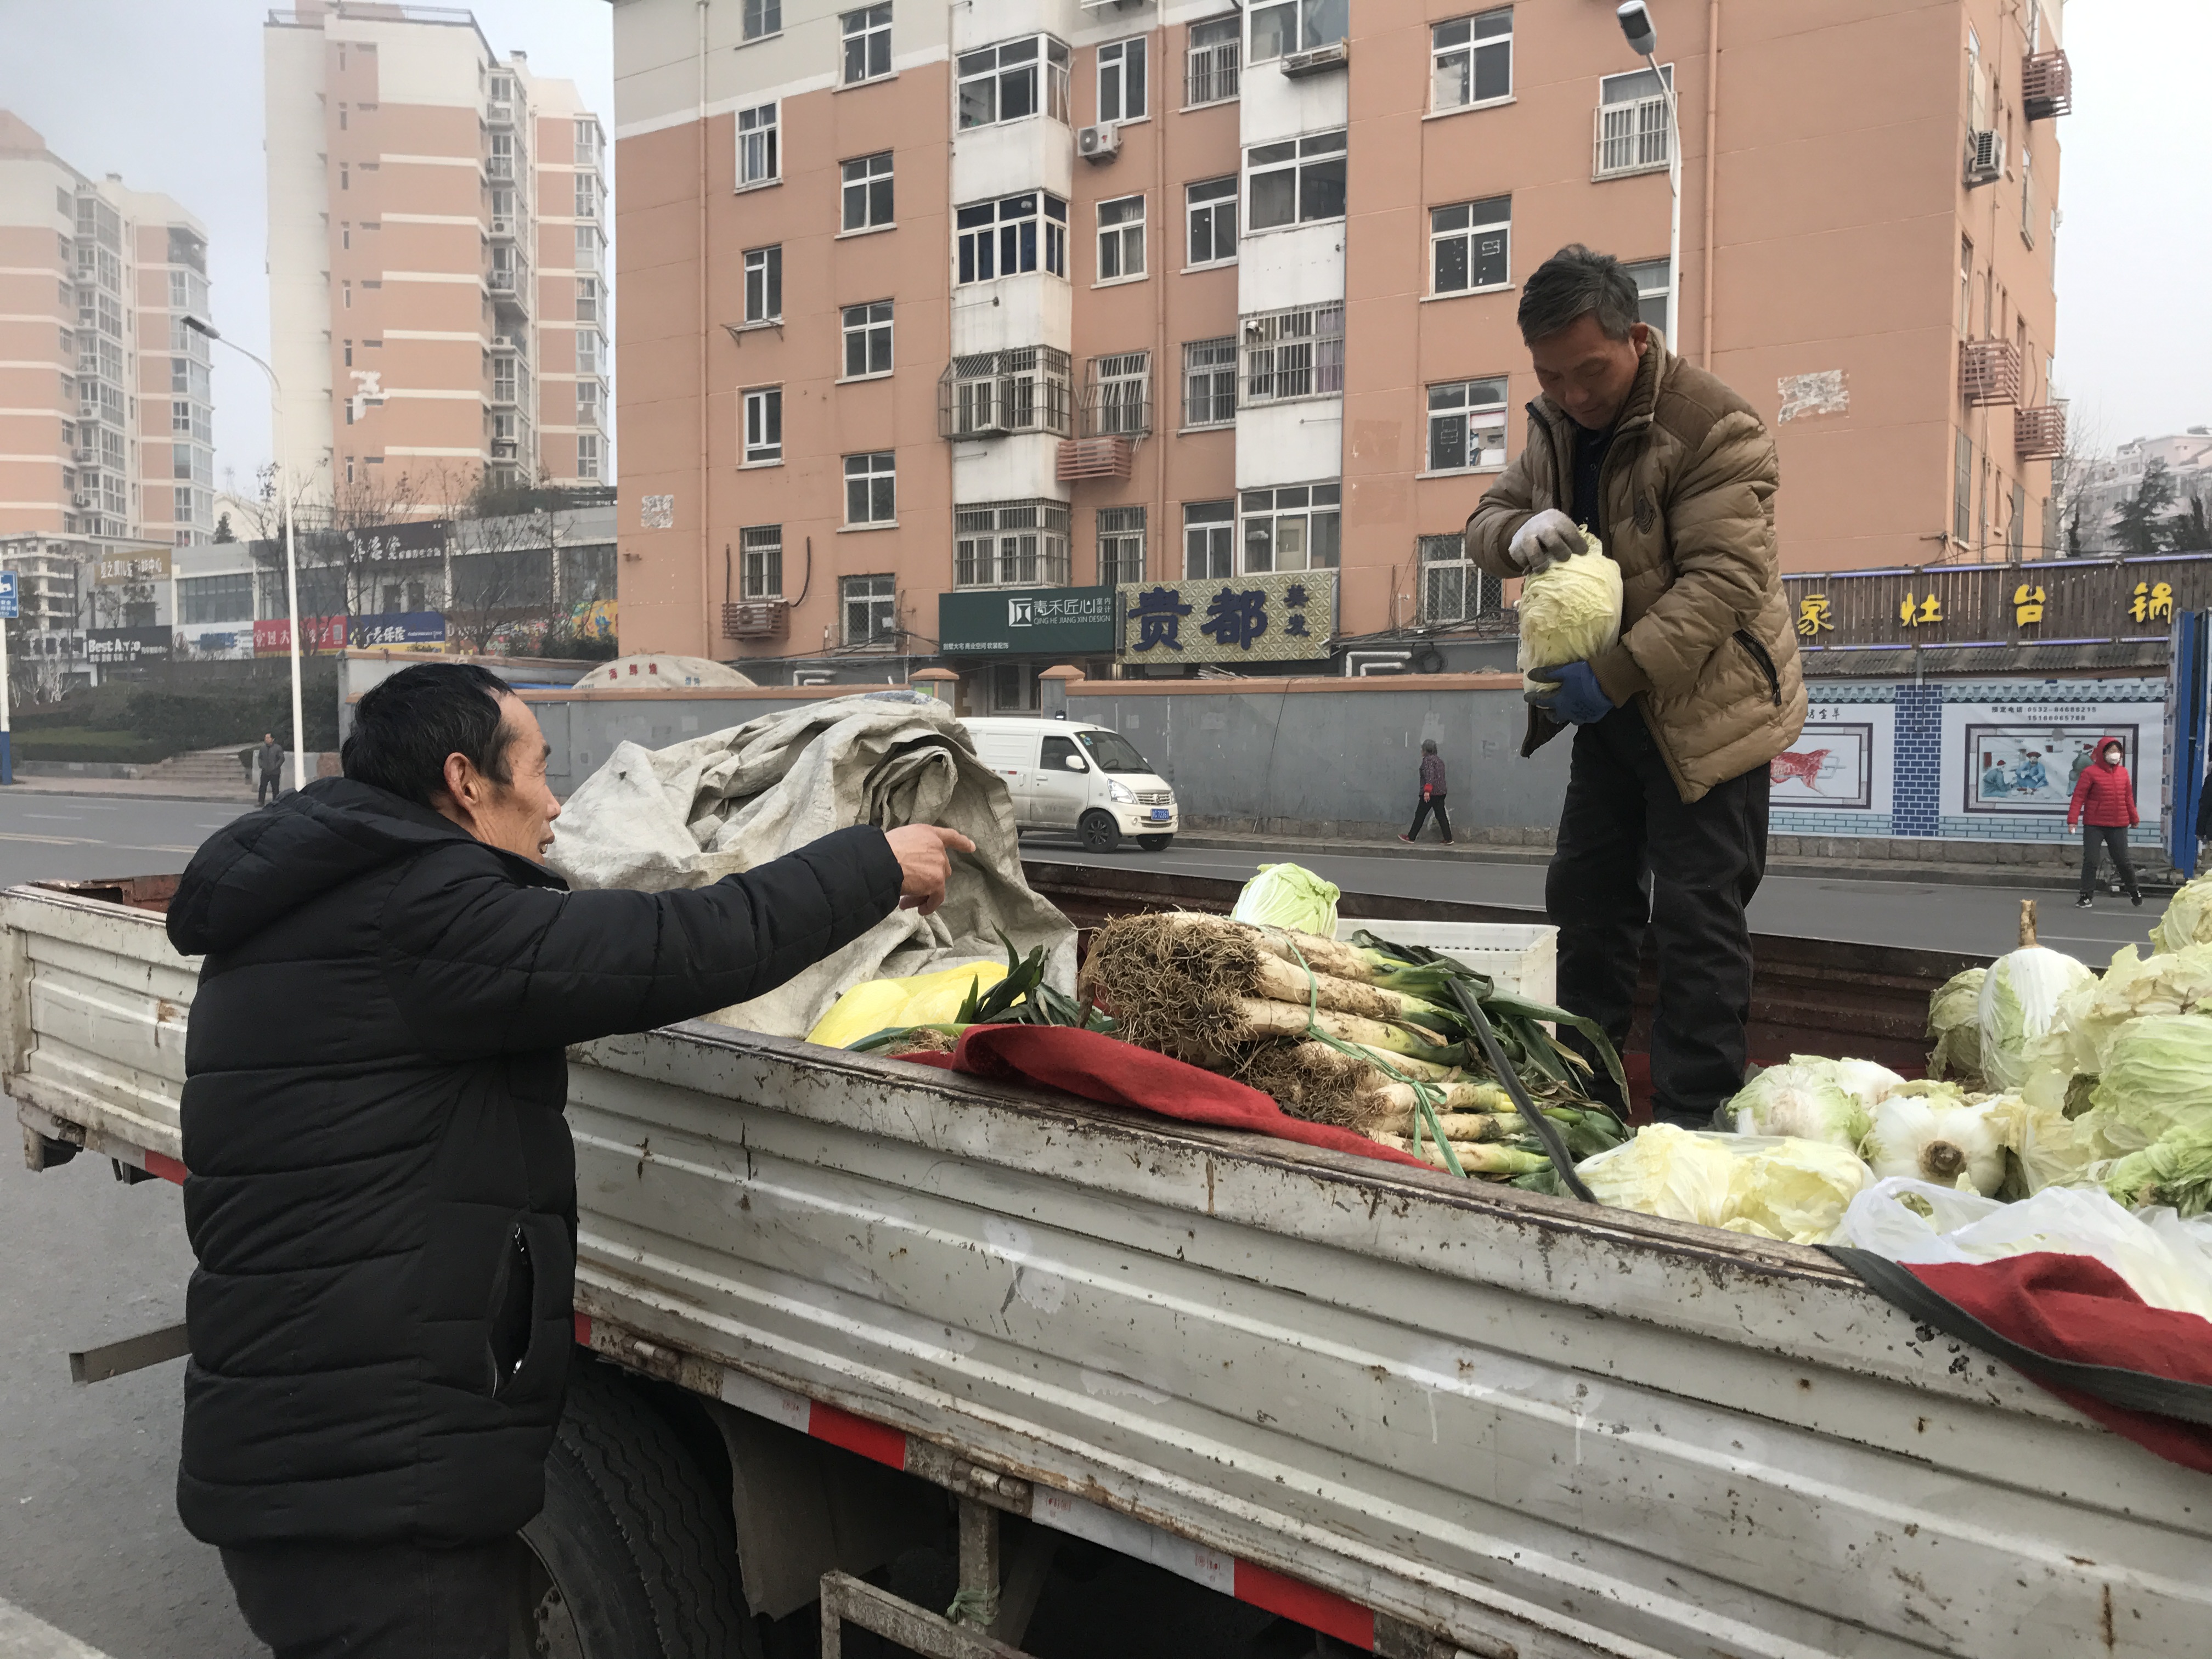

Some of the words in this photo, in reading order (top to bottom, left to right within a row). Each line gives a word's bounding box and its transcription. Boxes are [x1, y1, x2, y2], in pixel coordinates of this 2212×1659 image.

[1034, 599, 1092, 616] 青禾匠心
[1128, 586, 1268, 651] 贵都
[1283, 584, 1311, 637] 美发
